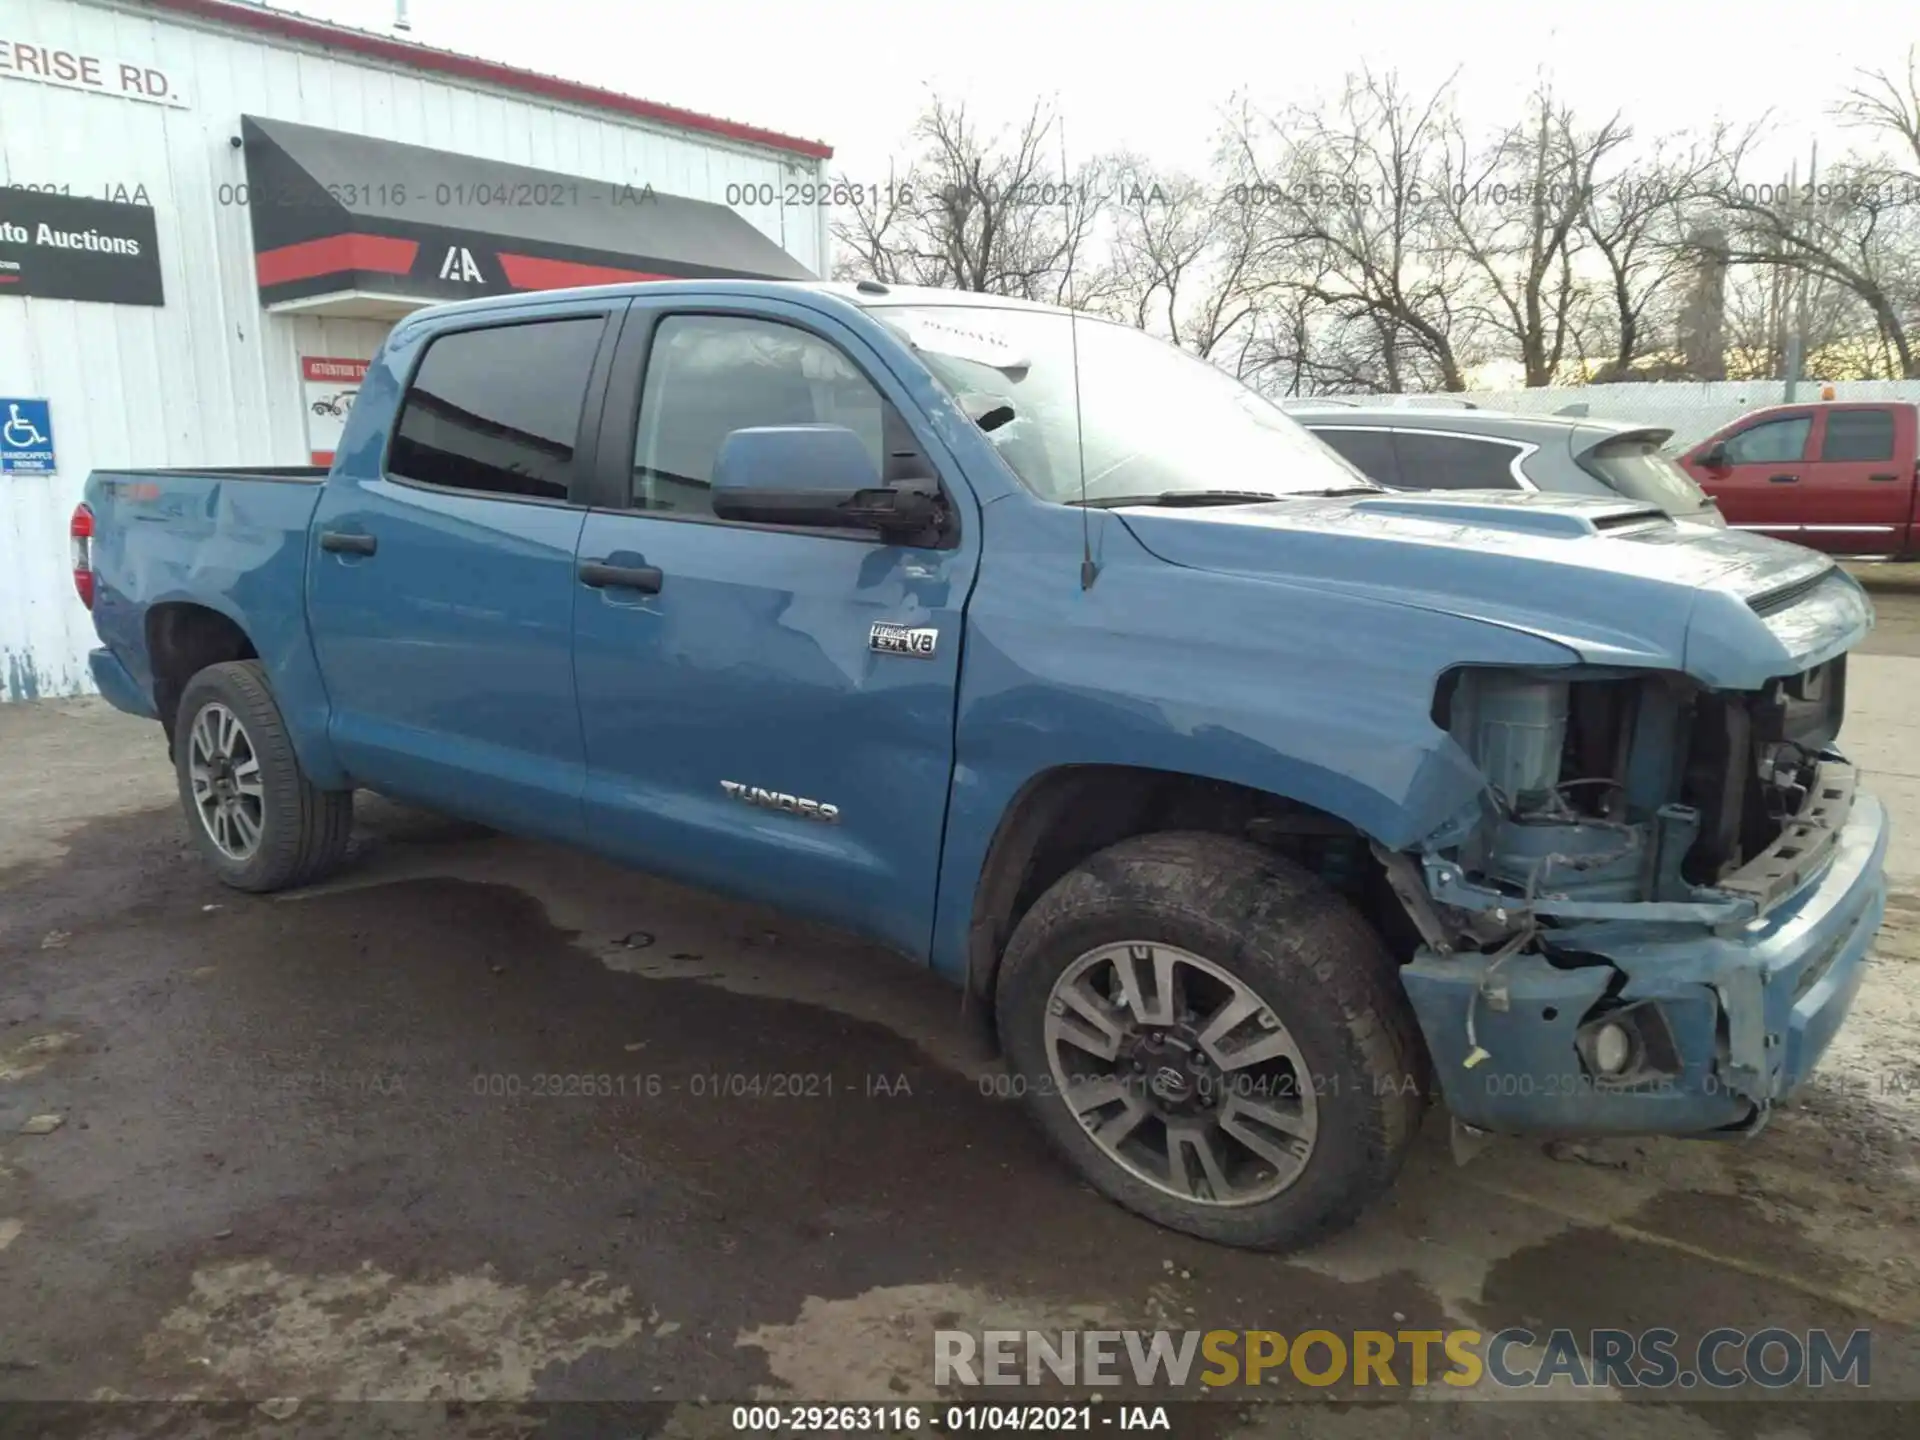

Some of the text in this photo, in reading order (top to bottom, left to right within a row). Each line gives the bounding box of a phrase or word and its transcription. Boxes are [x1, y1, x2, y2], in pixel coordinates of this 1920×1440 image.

[119, 64, 178, 100] RD.
[36, 222, 140, 255] Auctions
[910, 632, 934, 653] V8
